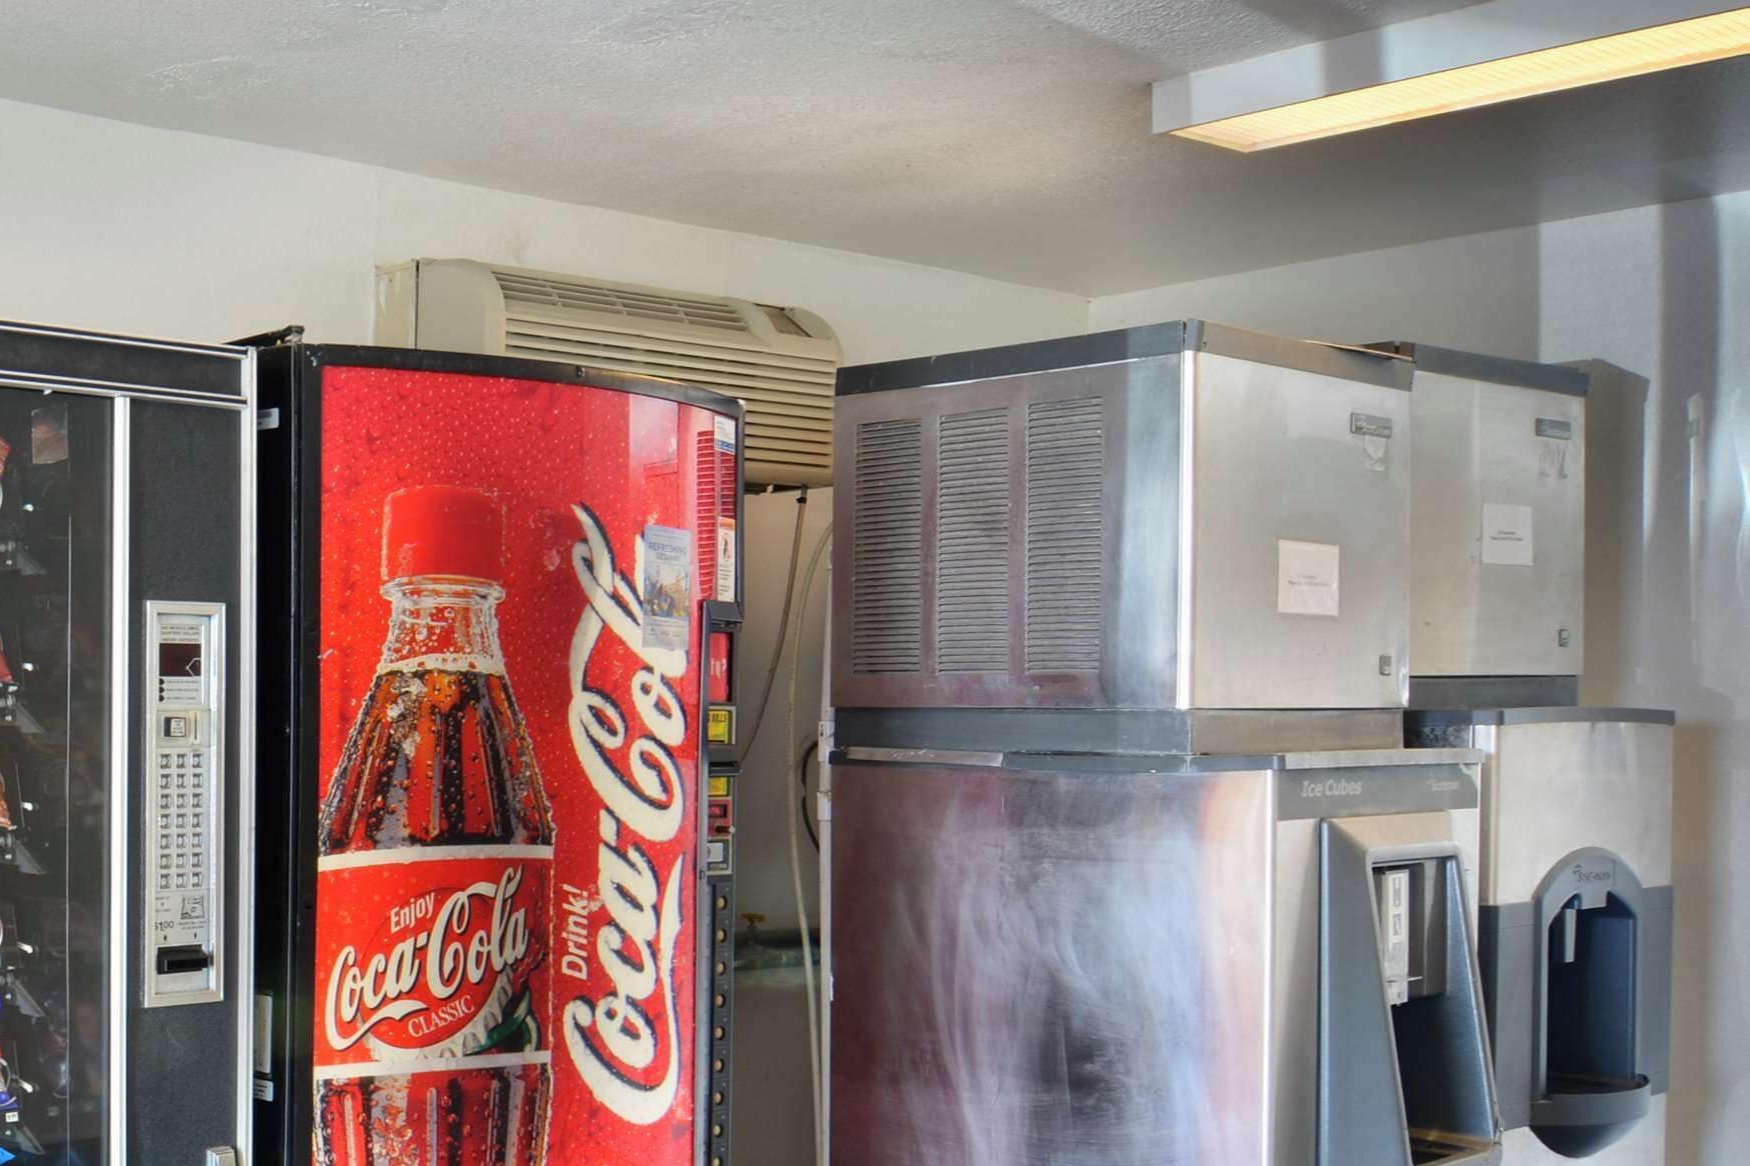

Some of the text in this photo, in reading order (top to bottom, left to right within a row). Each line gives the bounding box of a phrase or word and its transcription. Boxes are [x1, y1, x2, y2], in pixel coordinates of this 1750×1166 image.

[1301, 778, 1363, 798] Ice Cubes
[390, 892, 436, 934] Enjoy
[562, 883, 592, 981] Drink!
[325, 863, 529, 1051] Coca-Cola
[407, 994, 476, 1038] CLASSIC
